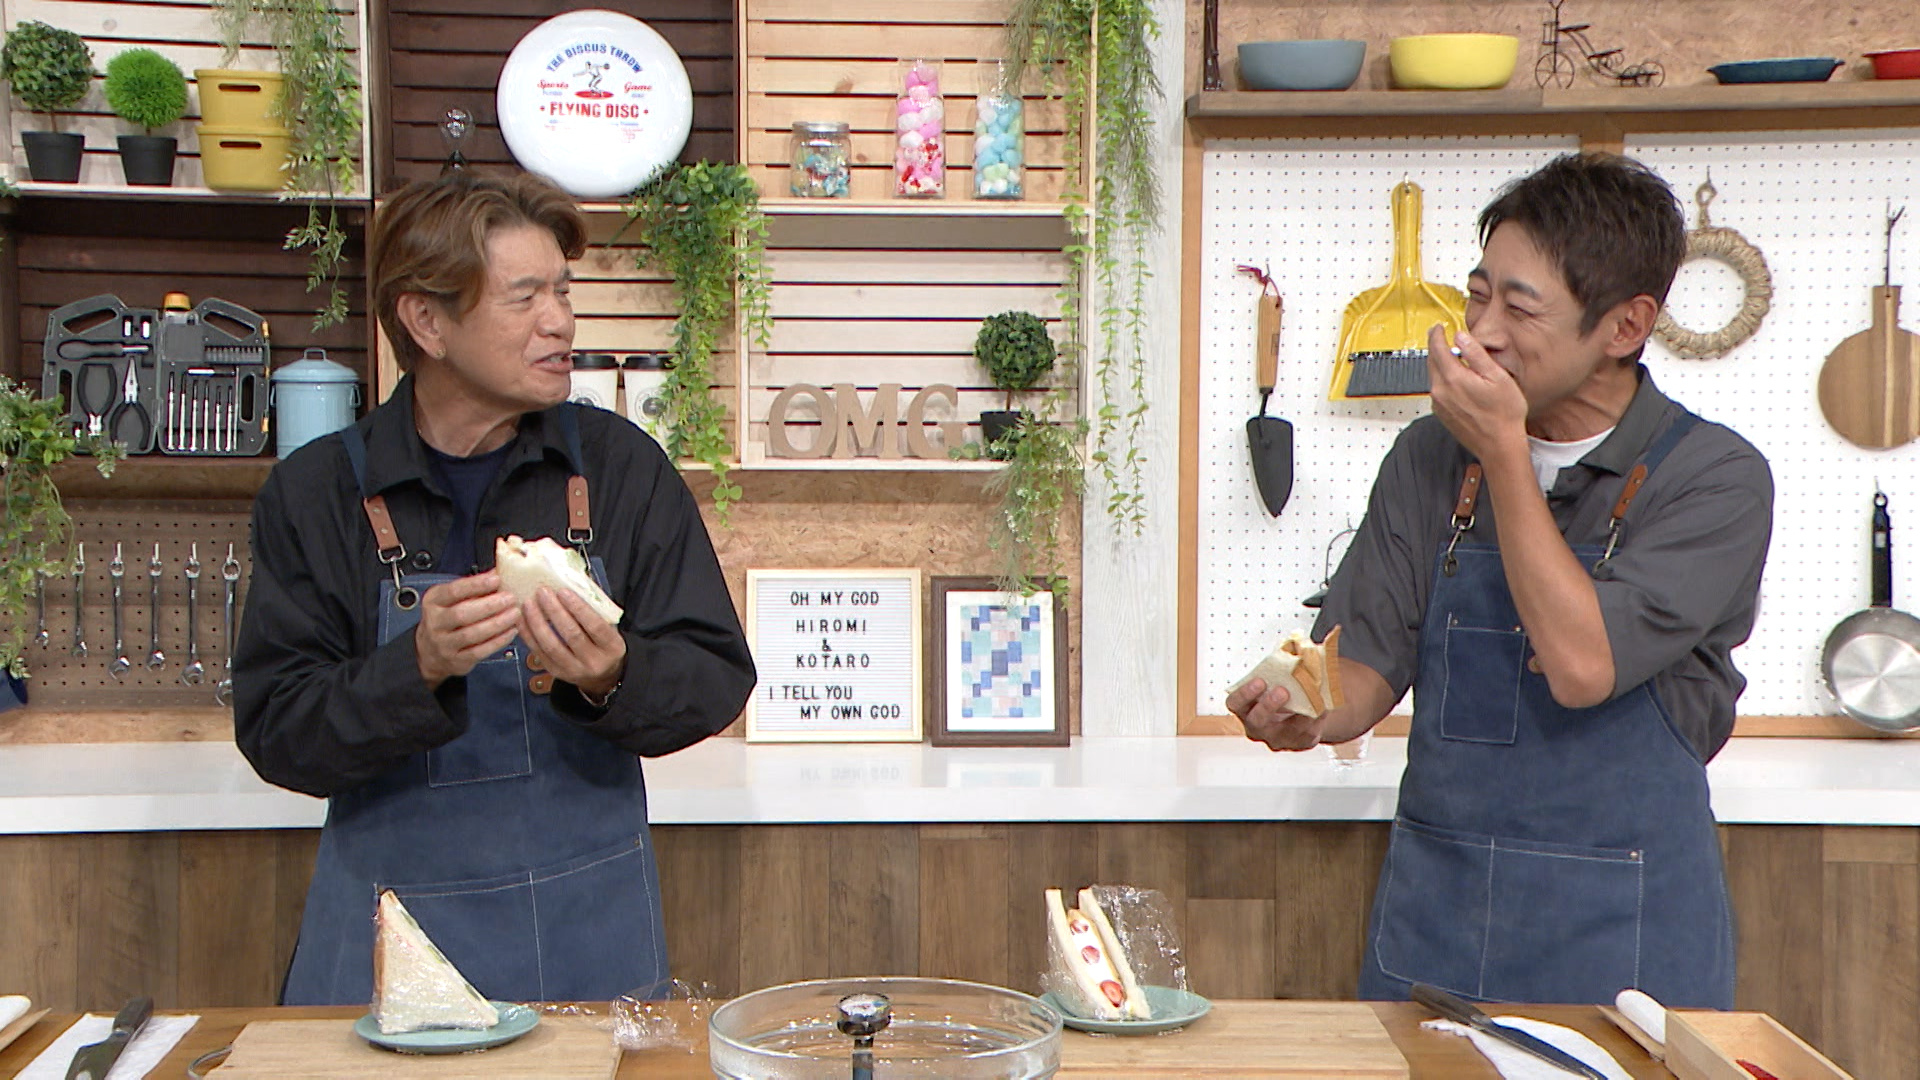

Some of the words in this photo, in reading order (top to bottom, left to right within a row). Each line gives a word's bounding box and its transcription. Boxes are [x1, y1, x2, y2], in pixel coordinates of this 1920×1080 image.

[546, 54, 565, 72] THE
[565, 43, 607, 58] DISCUS
[610, 45, 643, 73] THROW
[537, 79, 569, 92] Sports
[624, 81, 652, 94] Game
[550, 101, 601, 118] FLYING
[605, 102, 640, 119] DISC
[769, 383, 964, 459] OMG
[790, 591, 809, 606] OH
[820, 591, 843, 606] MY
[851, 591, 880, 606] GOD
[796, 619, 866, 634] HIROMI
[821, 638, 832, 652] &
[796, 653, 870, 668] KOTARO
[769, 685, 773, 700] I
[782, 685, 819, 700] TELL
[825, 685, 853, 700] YOU
[800, 705, 821, 720] MY
[831, 705, 862, 720] OWN
[870, 704, 901, 719] GOD
